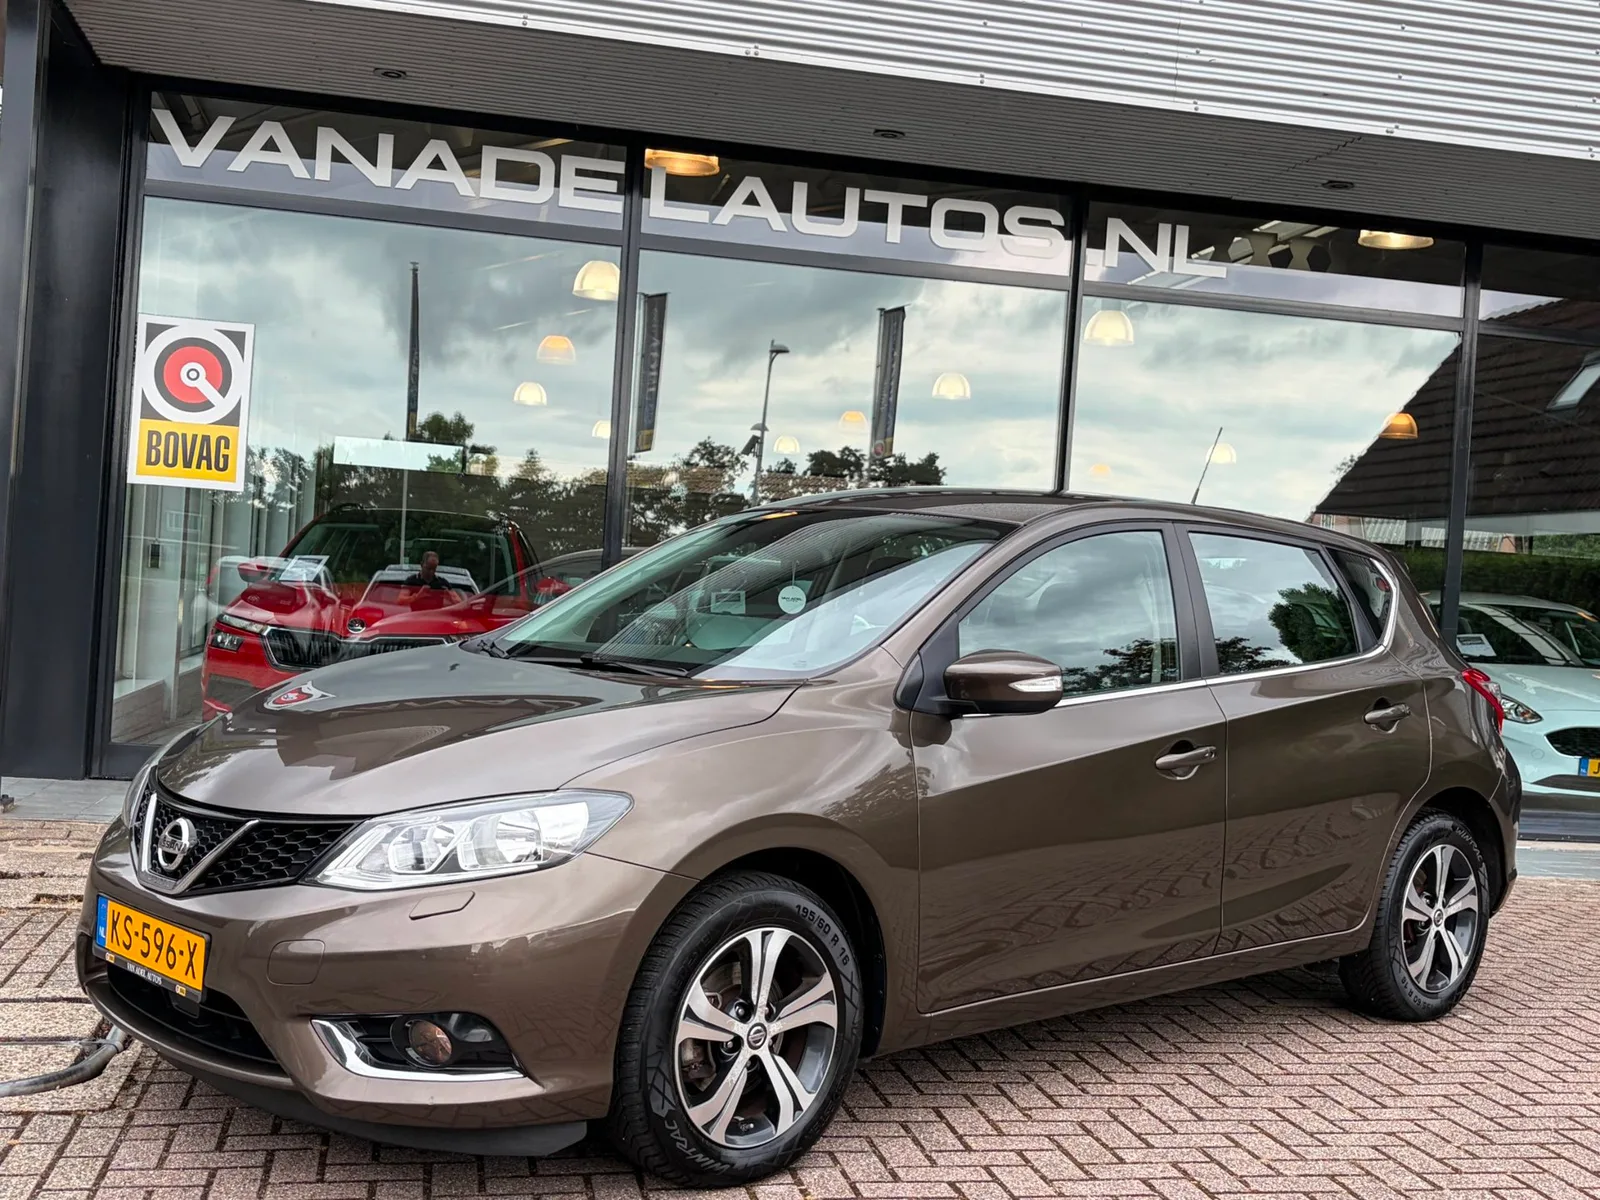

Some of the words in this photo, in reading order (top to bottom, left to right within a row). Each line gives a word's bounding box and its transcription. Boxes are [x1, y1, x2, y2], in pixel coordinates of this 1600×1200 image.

[146, 430, 230, 472] BOVAG
[111, 909, 198, 980] KS-596-X
[796, 905, 831, 935] 195/60
[831, 934, 839, 946] R
[839, 947, 850, 966] 16
[664, 1119, 730, 1175] WINTRAC
